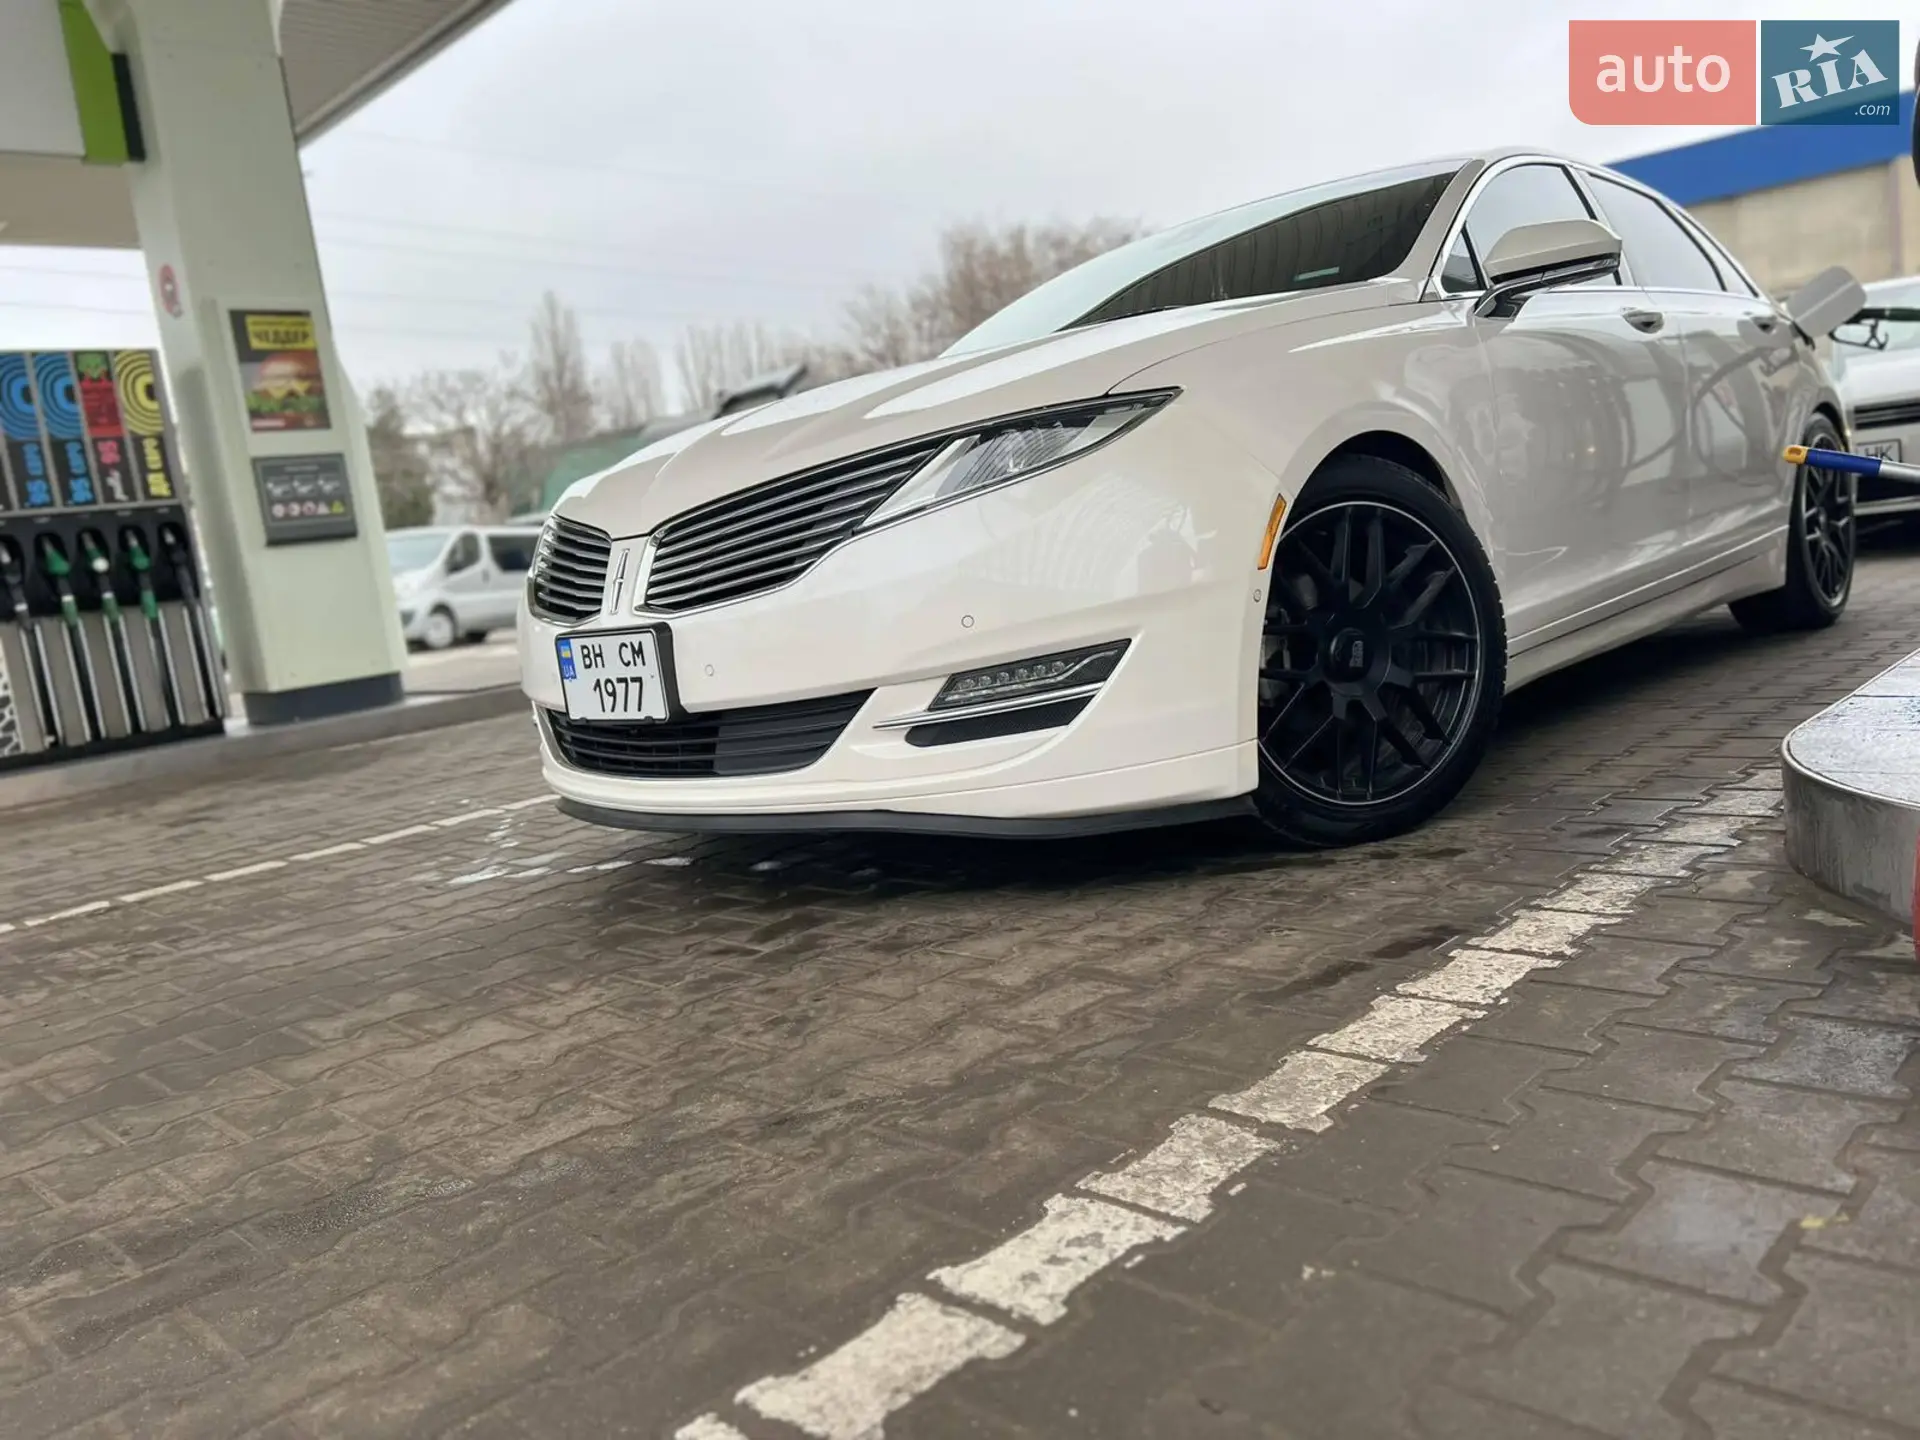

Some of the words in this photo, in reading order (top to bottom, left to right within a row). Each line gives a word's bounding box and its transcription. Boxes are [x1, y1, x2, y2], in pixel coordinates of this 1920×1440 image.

[580, 643, 605, 669] BH
[618, 640, 646, 667] CM
[563, 665, 576, 677] UA
[593, 676, 643, 713] 1977
